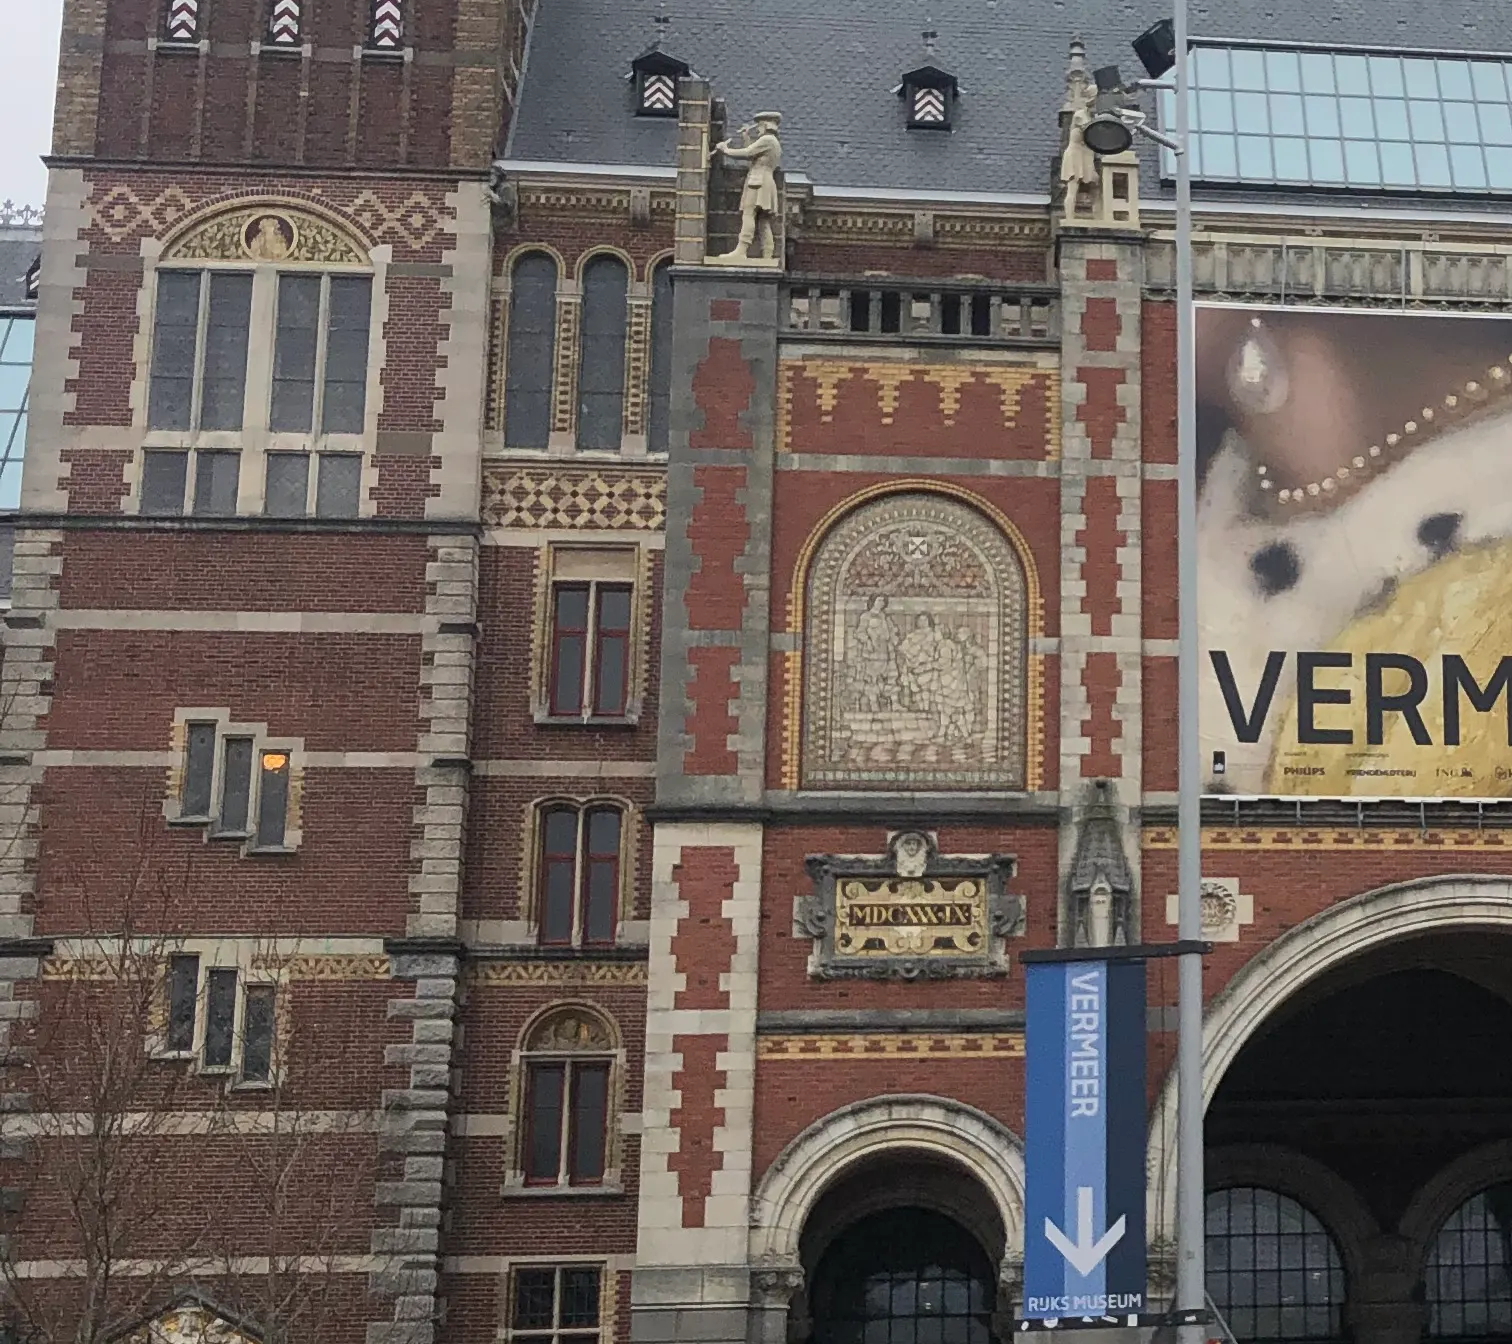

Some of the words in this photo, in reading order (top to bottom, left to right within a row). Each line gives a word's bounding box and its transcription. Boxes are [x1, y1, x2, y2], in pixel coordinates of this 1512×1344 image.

[1284, 767, 1325, 776] PHILIPS
[1071, 970, 1100, 1118] VERMEER
[1028, 1296, 1069, 1312] RIJKS
[1073, 1294, 1142, 1311] MUSEUM
